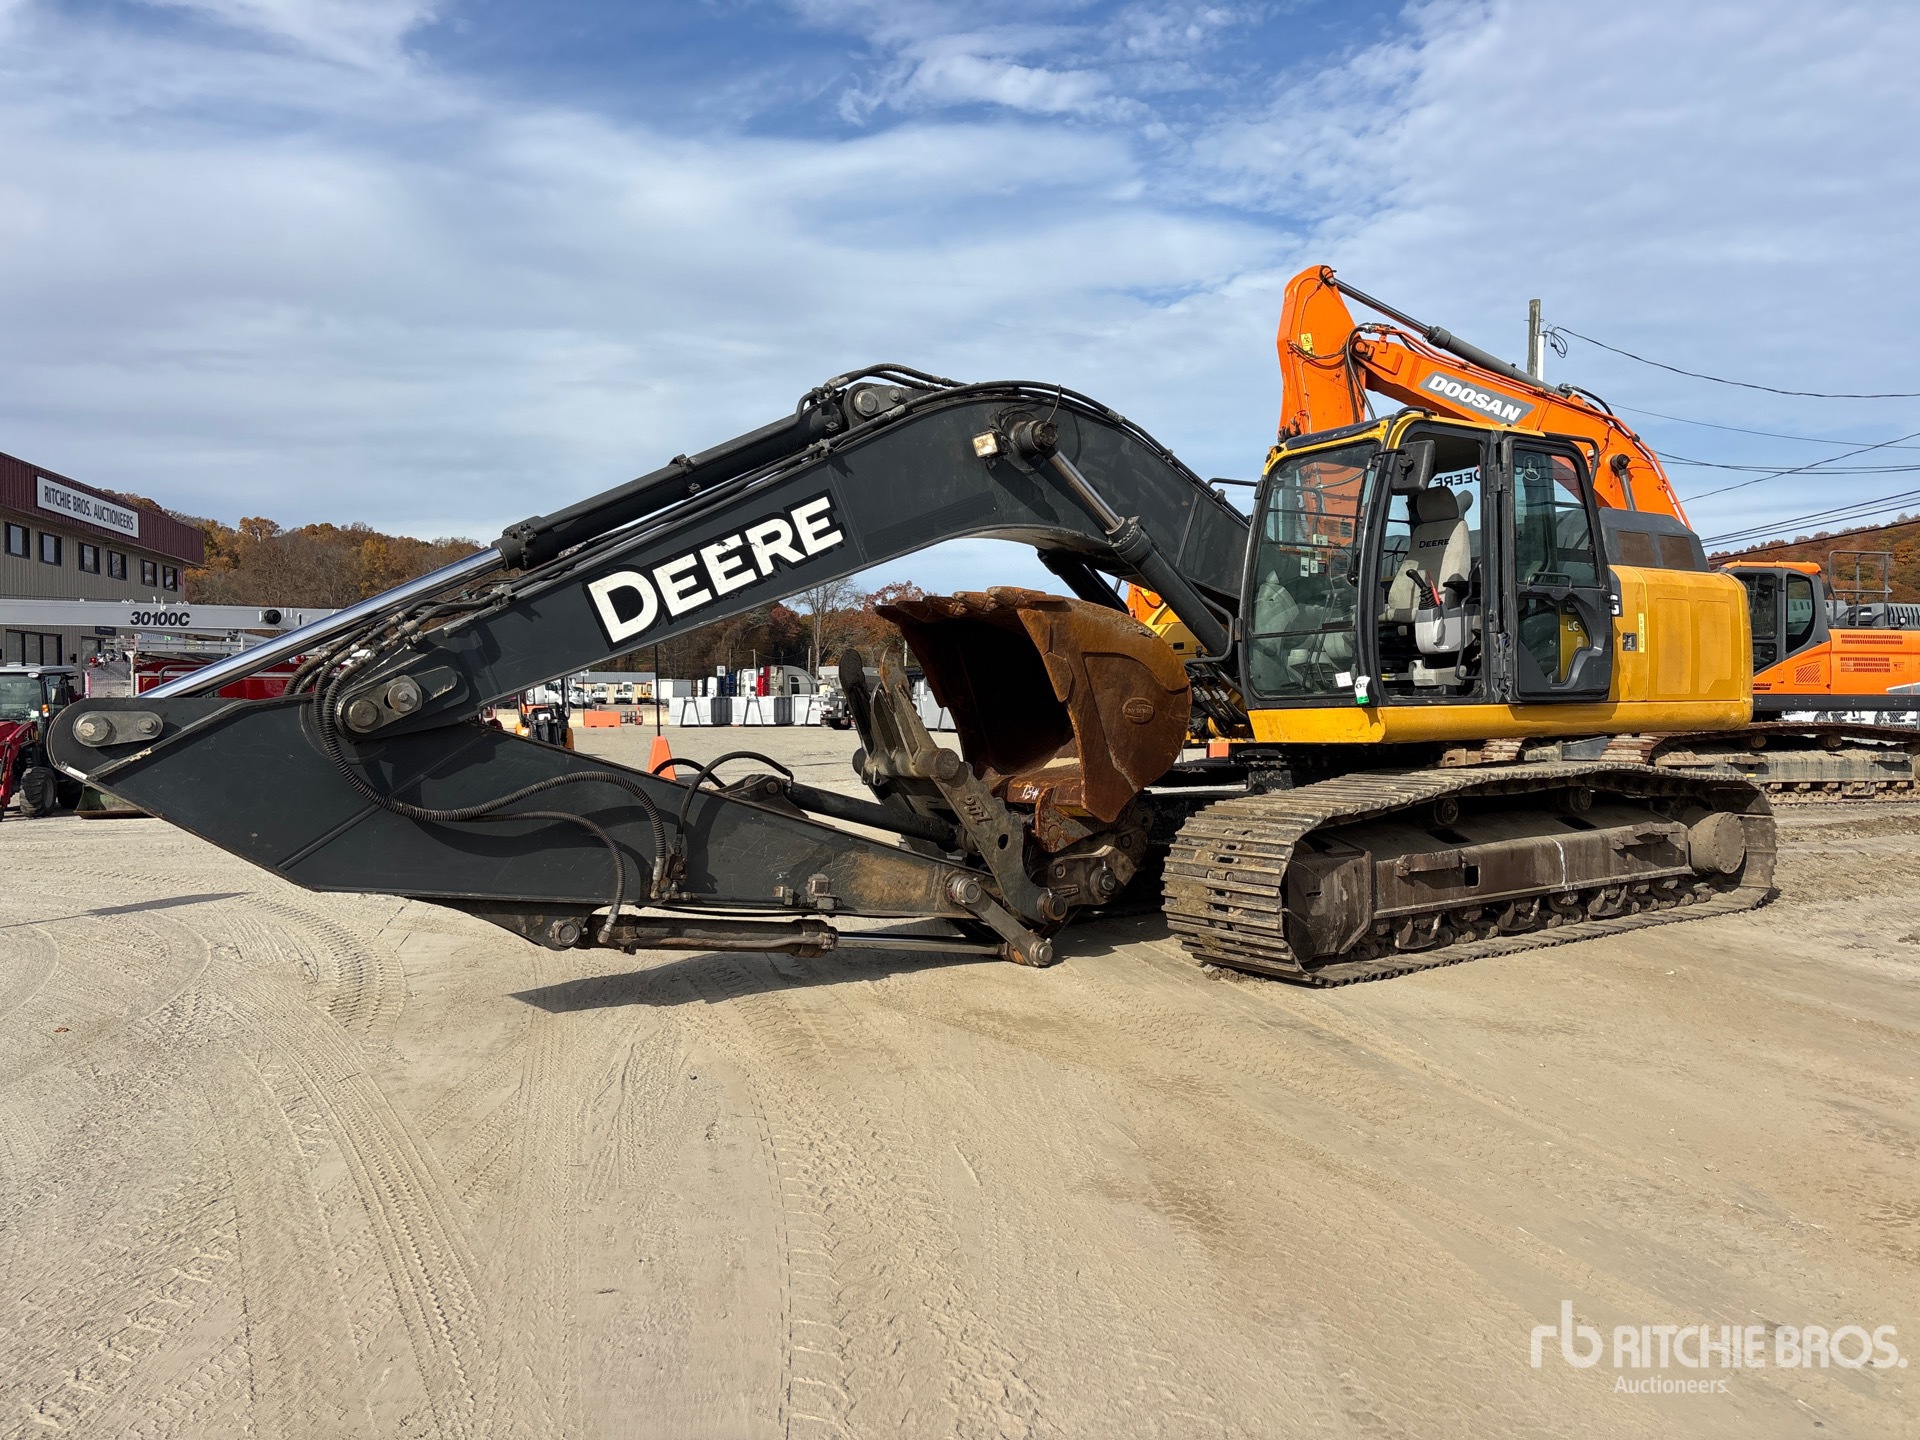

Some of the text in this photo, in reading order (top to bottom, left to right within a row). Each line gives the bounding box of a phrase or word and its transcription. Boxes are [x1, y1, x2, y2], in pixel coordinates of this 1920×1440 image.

[1427, 375, 1522, 422] DOOSAN
[44, 485, 134, 531] RITCHIE BROS. AUCTIONEERS
[1418, 538, 1450, 549] DEERE
[587, 496, 844, 644] DEERE
[130, 611, 191, 626] 30100C
[1567, 620, 1579, 631] LC
